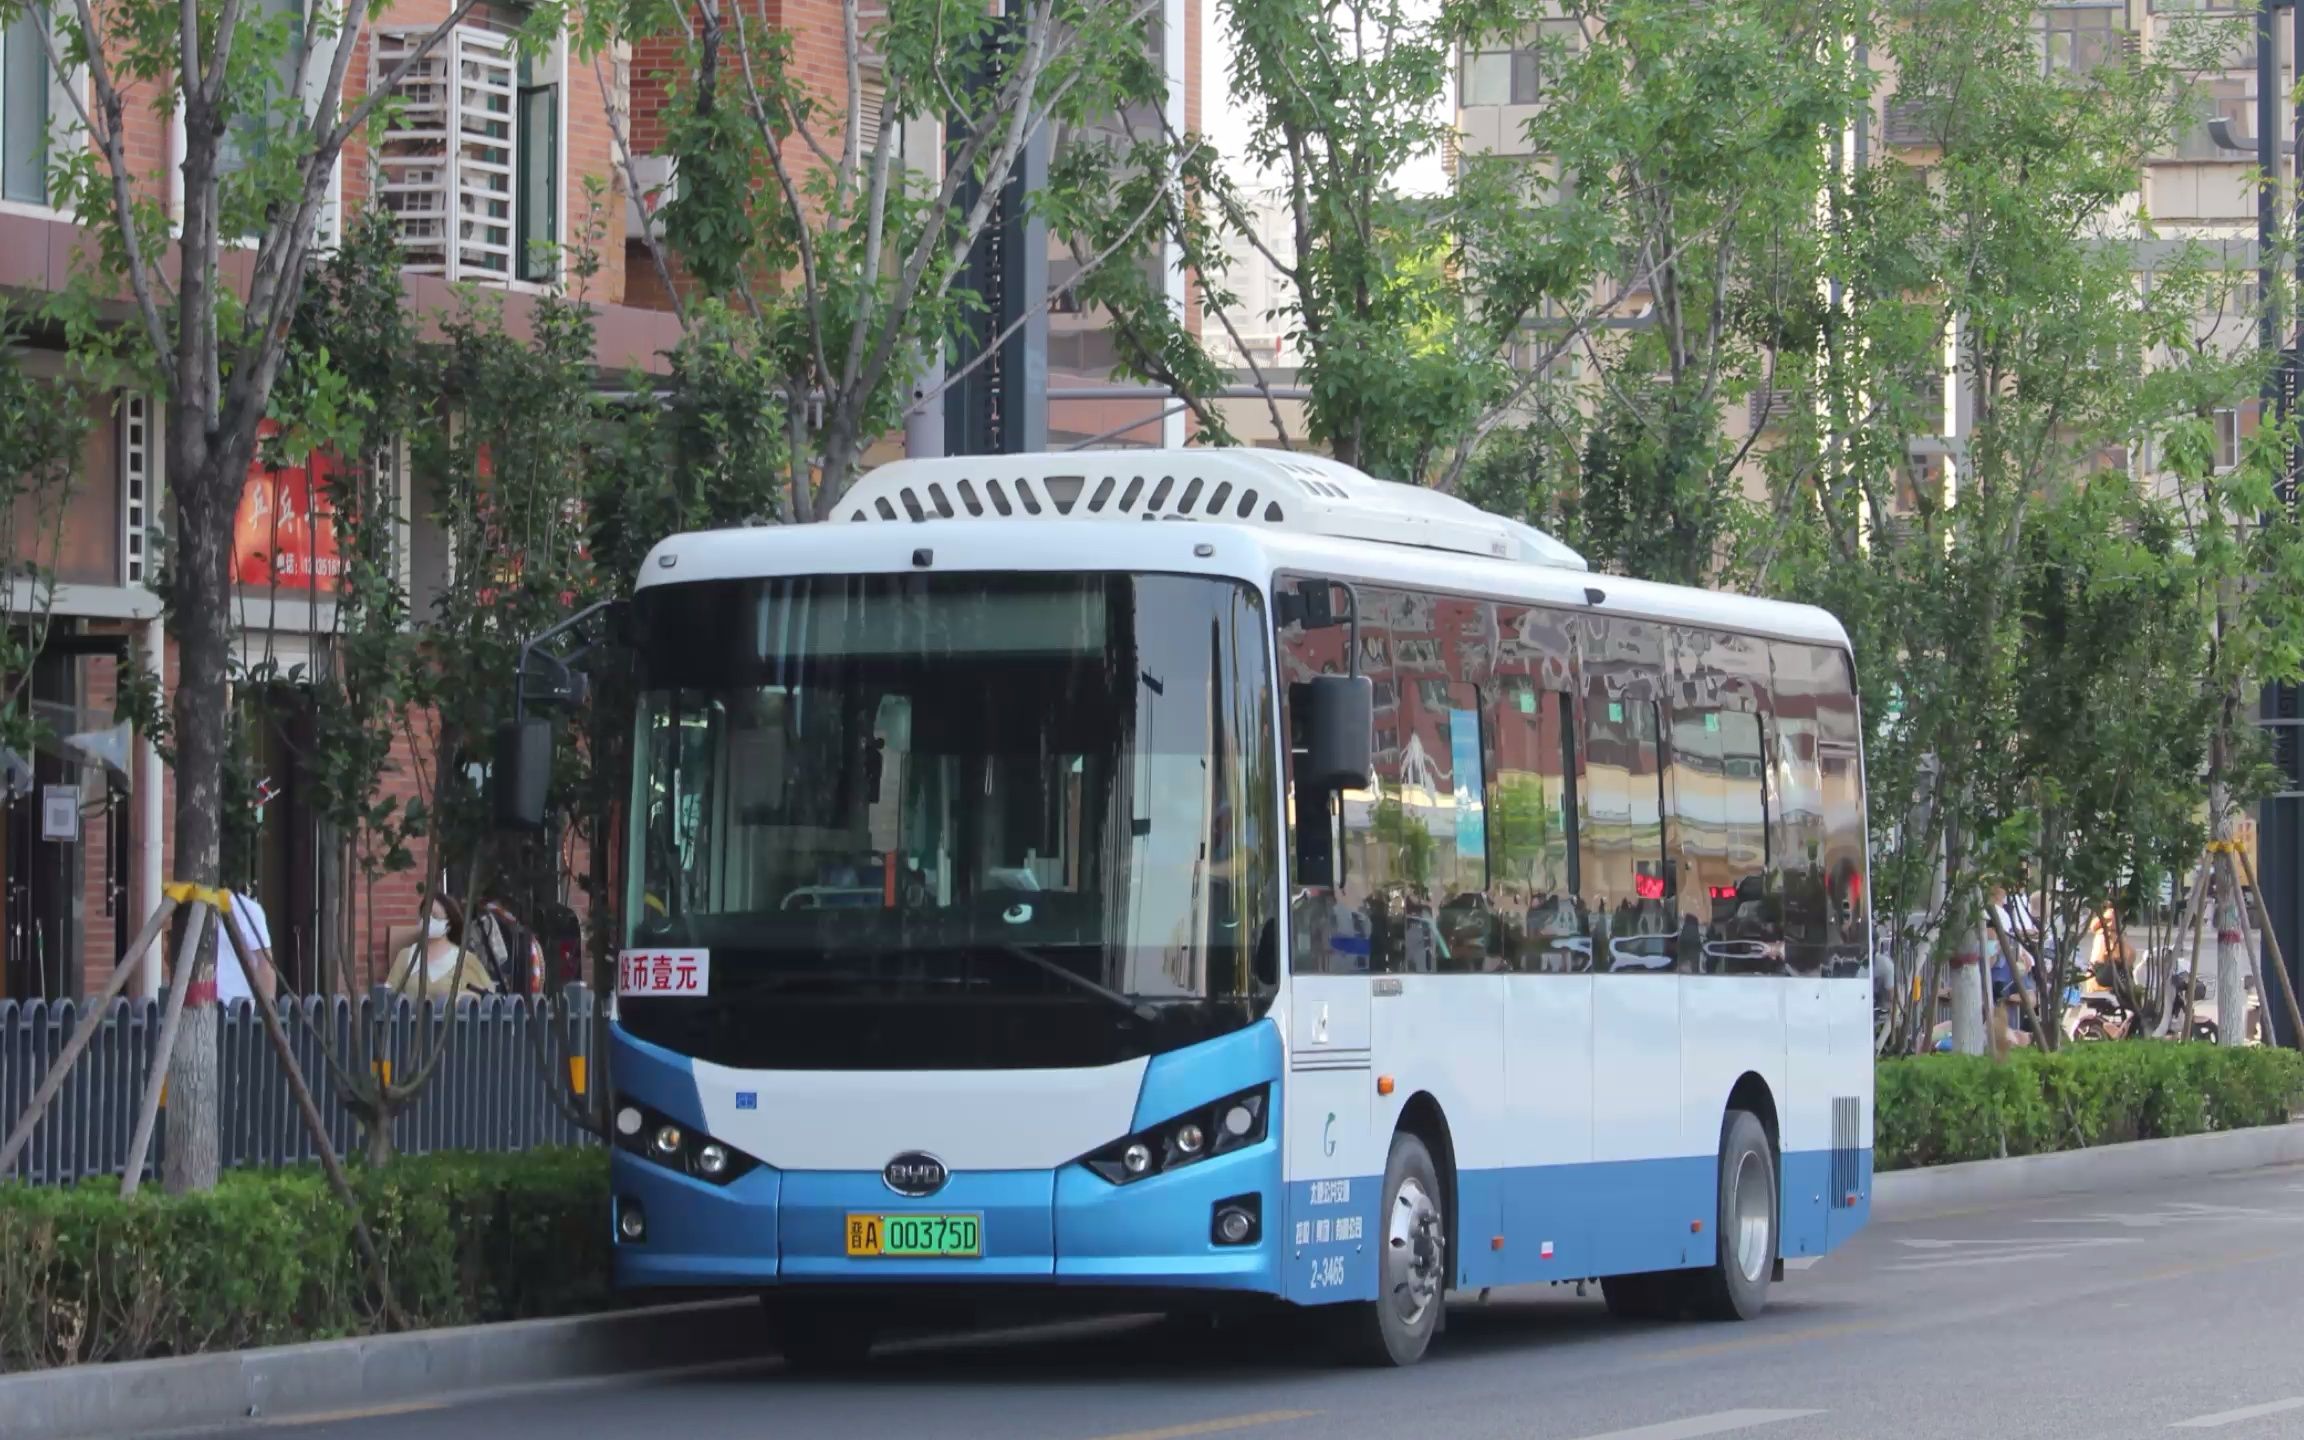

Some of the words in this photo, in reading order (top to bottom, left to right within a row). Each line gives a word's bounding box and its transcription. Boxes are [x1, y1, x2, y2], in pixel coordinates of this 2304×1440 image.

[620, 954, 698, 991] 投币壹元
[890, 1164, 940, 1184] BYD
[1310, 1256, 1344, 1288] 2-3465
